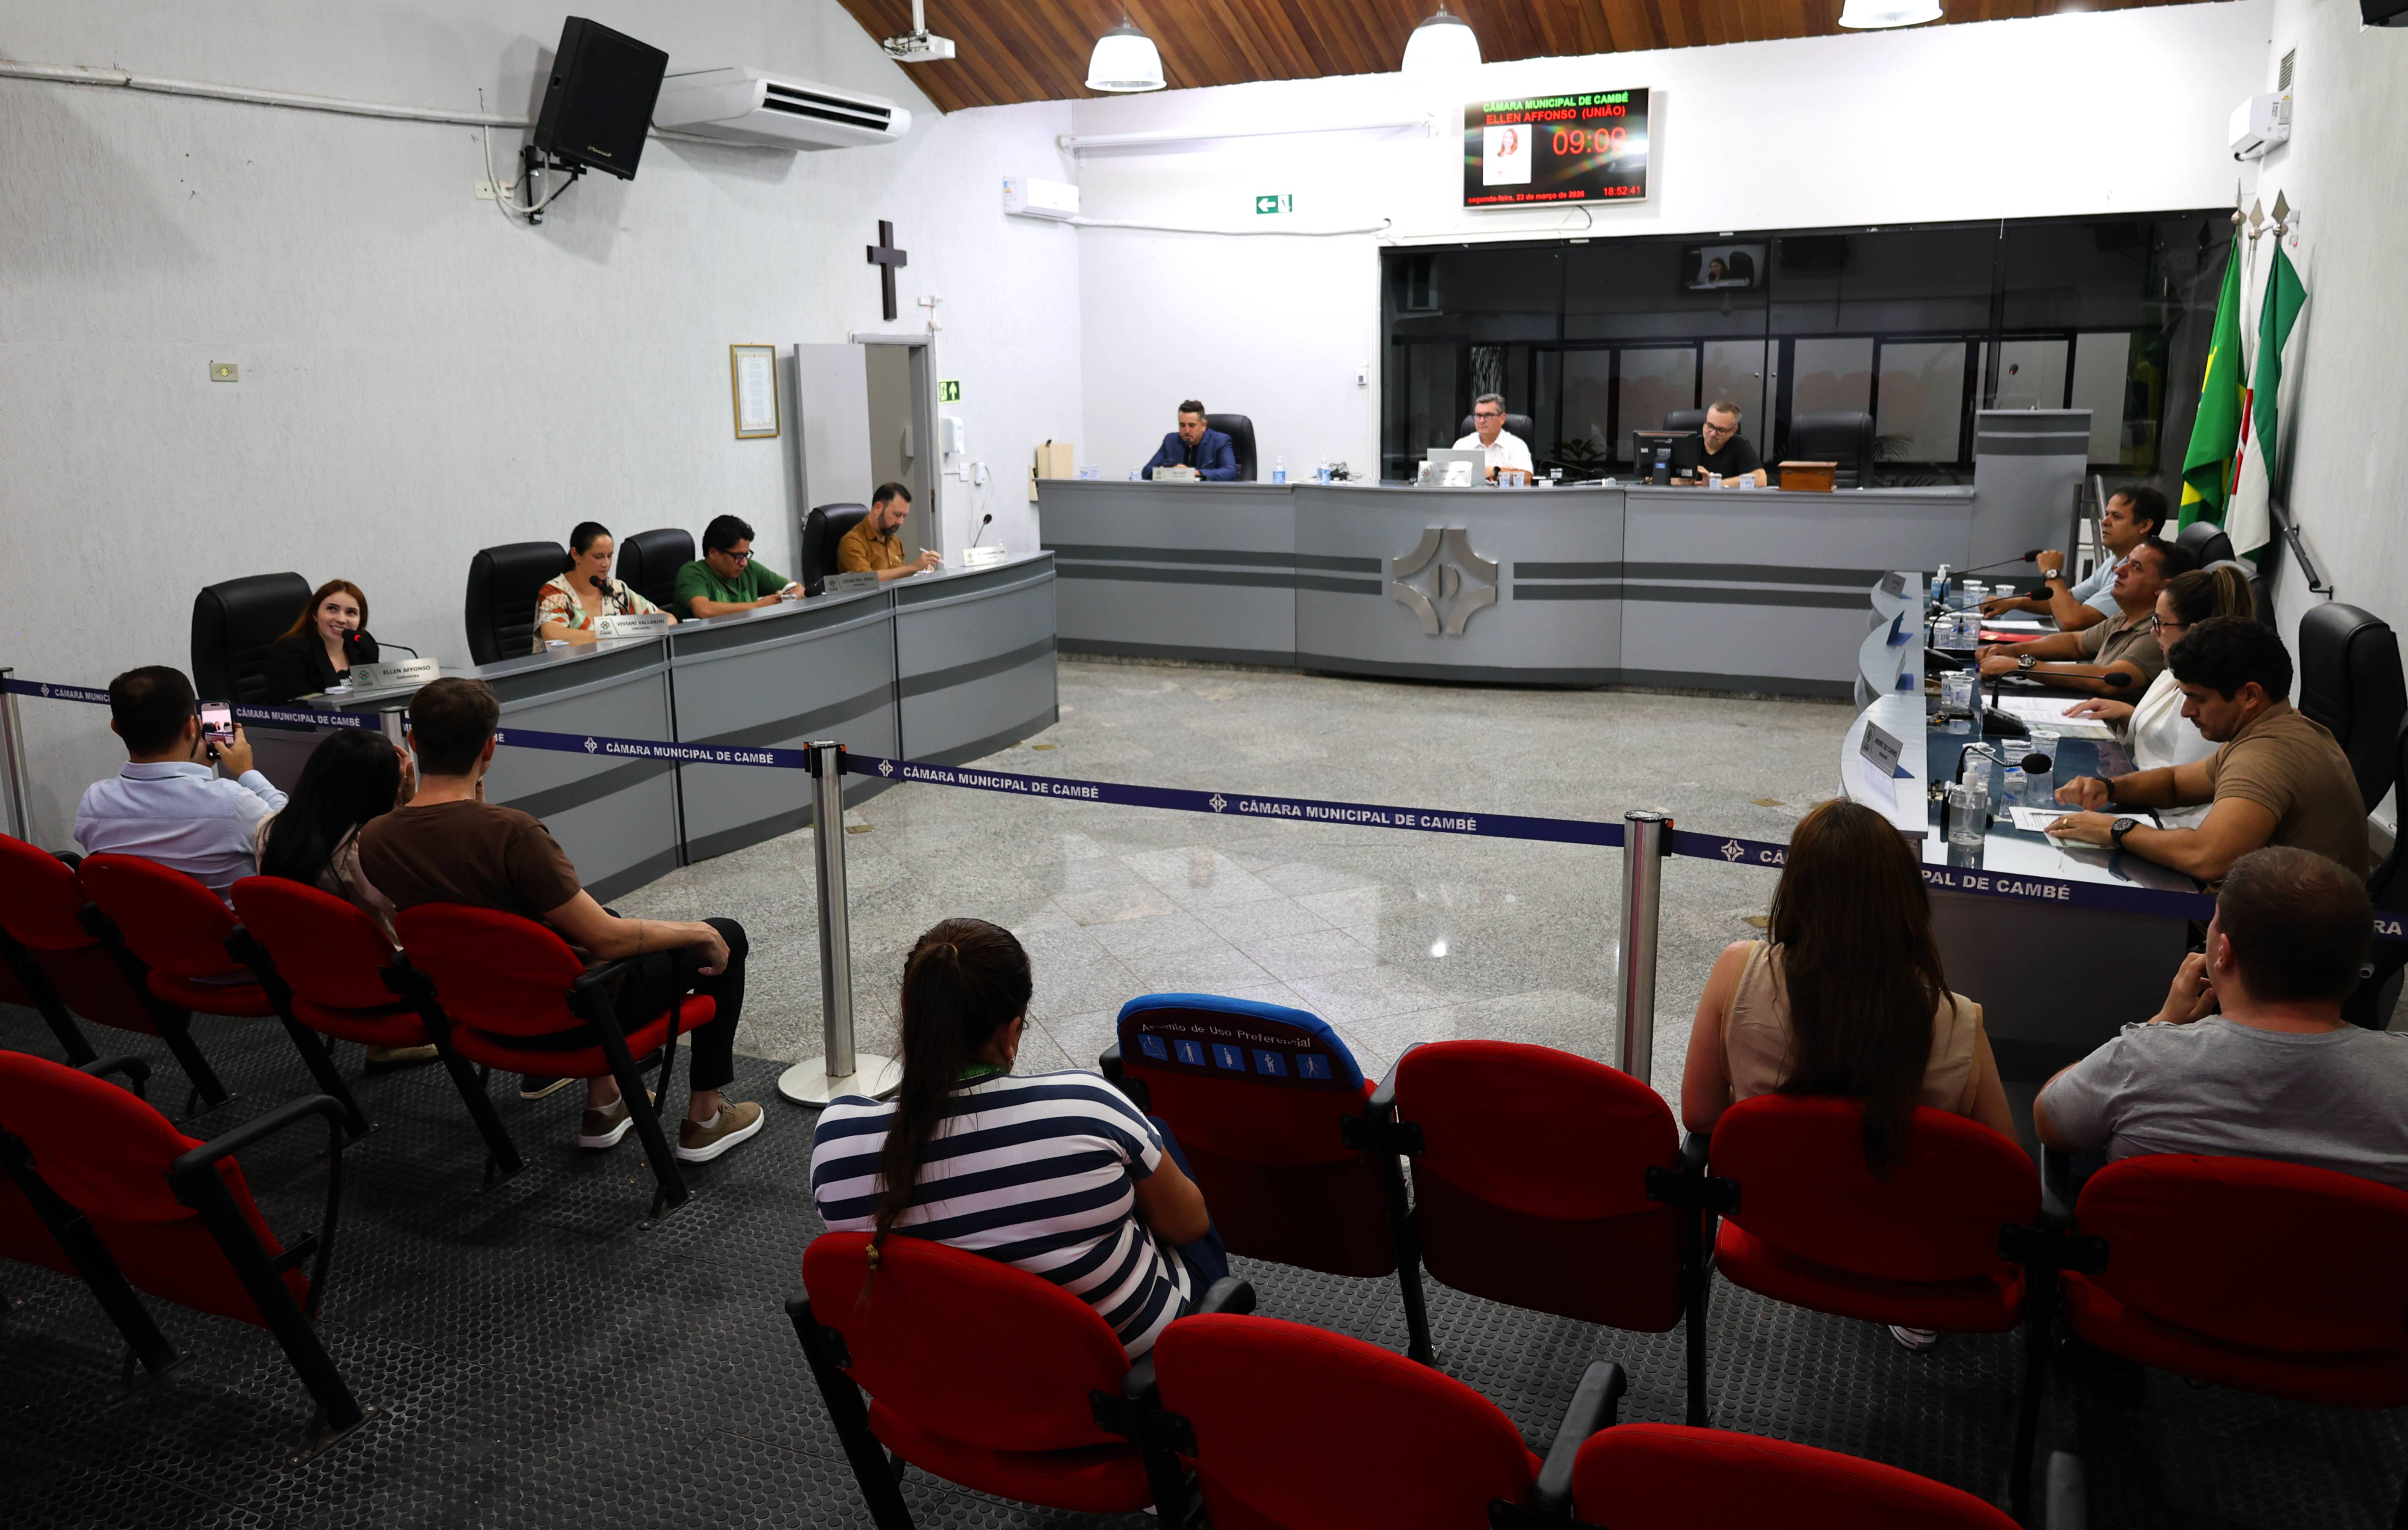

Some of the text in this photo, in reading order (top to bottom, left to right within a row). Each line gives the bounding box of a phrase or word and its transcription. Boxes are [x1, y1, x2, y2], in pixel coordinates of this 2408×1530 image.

[1483, 91, 1629, 113] CÂMARA MUNICIPAL DE CAMBÉ
[1486, 105, 1626, 125] ELLEN AFFONSO (UNIÃO)
[1468, 195, 1515, 204] segunda-feira,
[1568, 190, 1585, 198] 2026
[1603, 186, 1641, 196] 18:52:41
[55, 688, 110, 702] CÂMARA MUNICI
[236, 707, 361, 727] CÂMARA MUNICIPAL DE CAMBÉ
[606, 742, 774, 764] CÂMARA MUNICIPAL DE CAMBÉ
[903, 766, 1099, 798] CÂMARA MUNICIPAL DE CAMBÉ
[1239, 799, 1477, 831] CÂMARA MUNICIPAL DE CAMBÉ
[1963, 875, 1990, 890] DE
[1996, 879, 2071, 900] CAMBÉ
[1191, 1024, 1204, 1033] de
[1209, 1026, 1231, 1036] Uso
